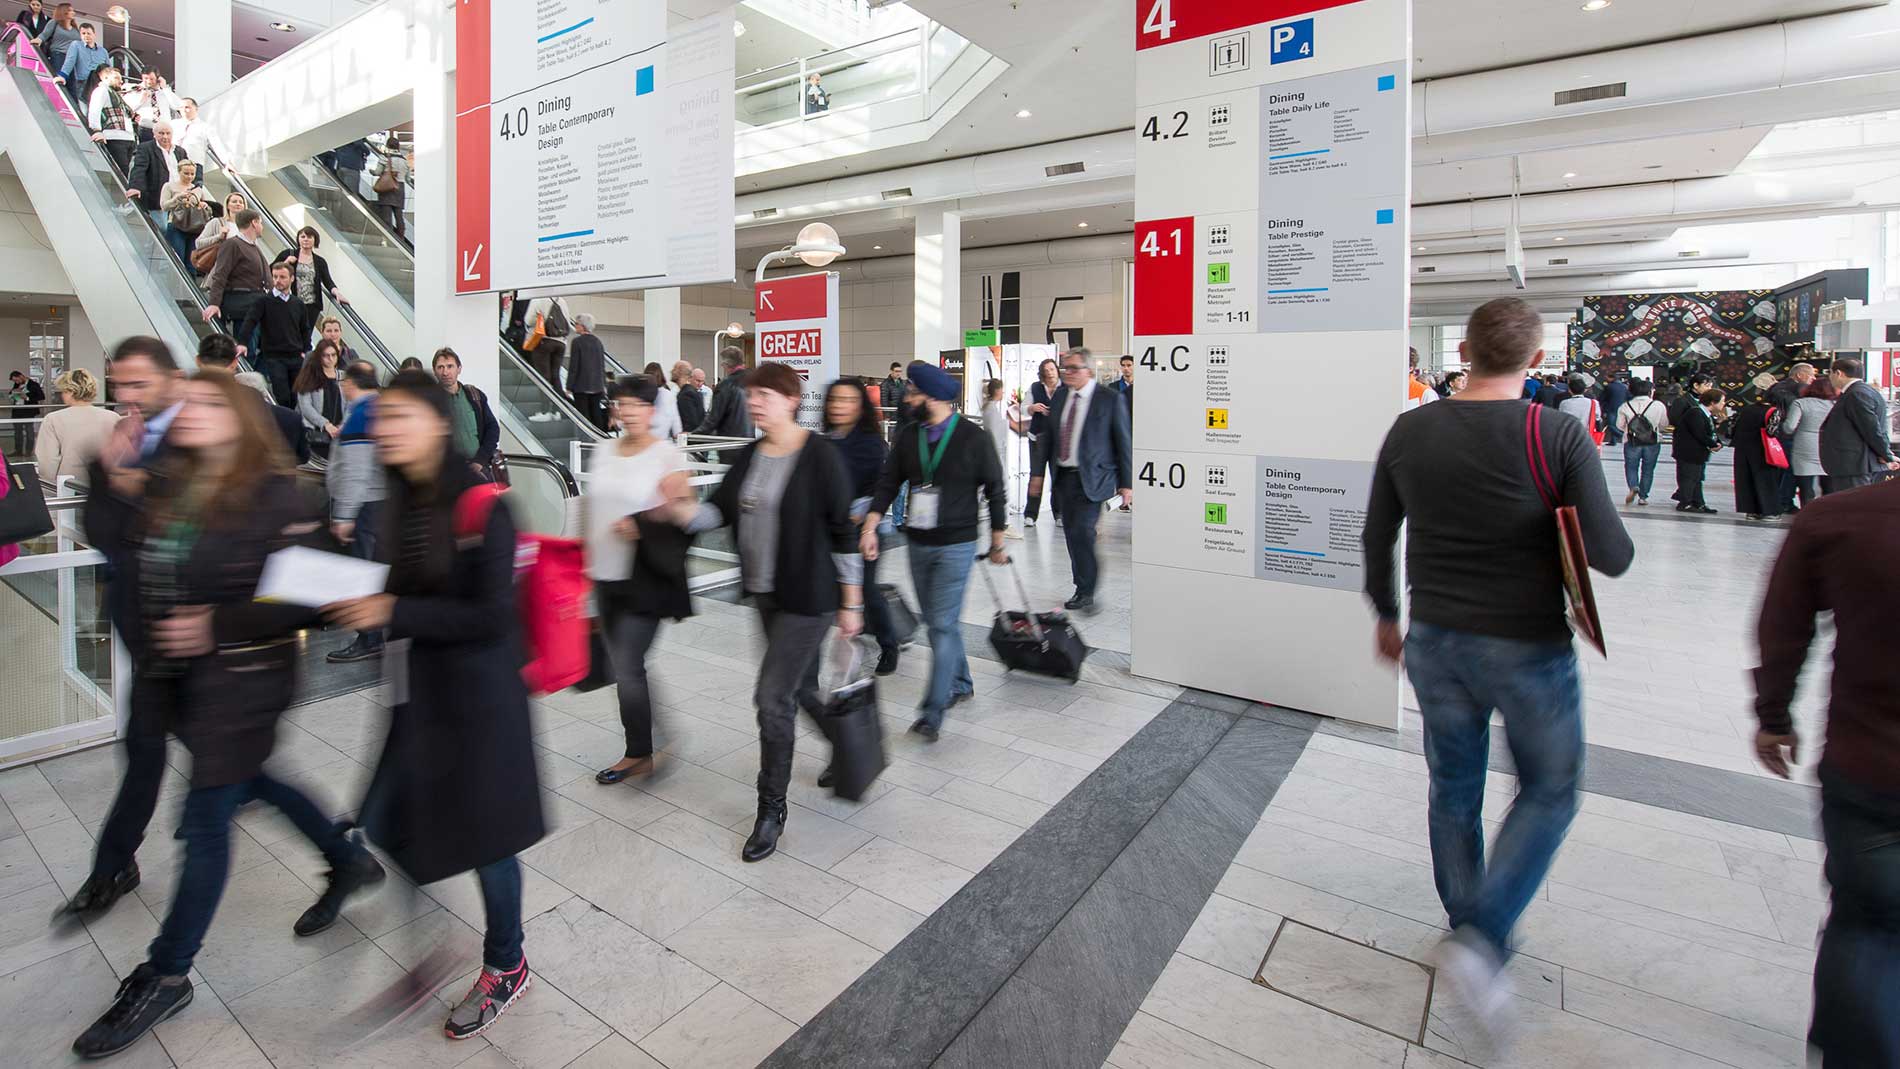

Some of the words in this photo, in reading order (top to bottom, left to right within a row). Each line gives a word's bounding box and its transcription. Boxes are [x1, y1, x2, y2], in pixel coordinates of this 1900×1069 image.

[1143, 0, 1177, 40] 4
[1273, 26, 1296, 54] P
[1299, 41, 1310, 55] 4
[538, 95, 571, 116] Dining
[1269, 92, 1305, 105] Dining
[1269, 108, 1290, 116] Table
[1292, 104, 1312, 113] Daily
[1314, 101, 1330, 109] Life
[500, 106, 529, 141] 4.0
[538, 122, 557, 136] Table
[558, 106, 615, 130] Contemporary
[1142, 110, 1189, 142] 4.2
[538, 136, 564, 150] Design
[1268, 218, 1304, 229] Dining
[1140, 228, 1181, 257] 4.1
[1268, 233, 1289, 241] Table
[1290, 230, 1324, 238] Prestige
[1226, 311, 1249, 322] 1-11
[1645, 299, 1677, 320] WHITE
[1681, 300, 1707, 319] PARK
[762, 332, 819, 355] GREAT
[1139, 345, 1190, 372] 4.C
[811, 391, 822, 400] Tea
[1138, 461, 1186, 489] 4.0
[1265, 468, 1301, 481] Dining
[1265, 482, 1286, 490] Table
[1288, 483, 1346, 495] Contemporary
[1265, 490, 1293, 500] Design
